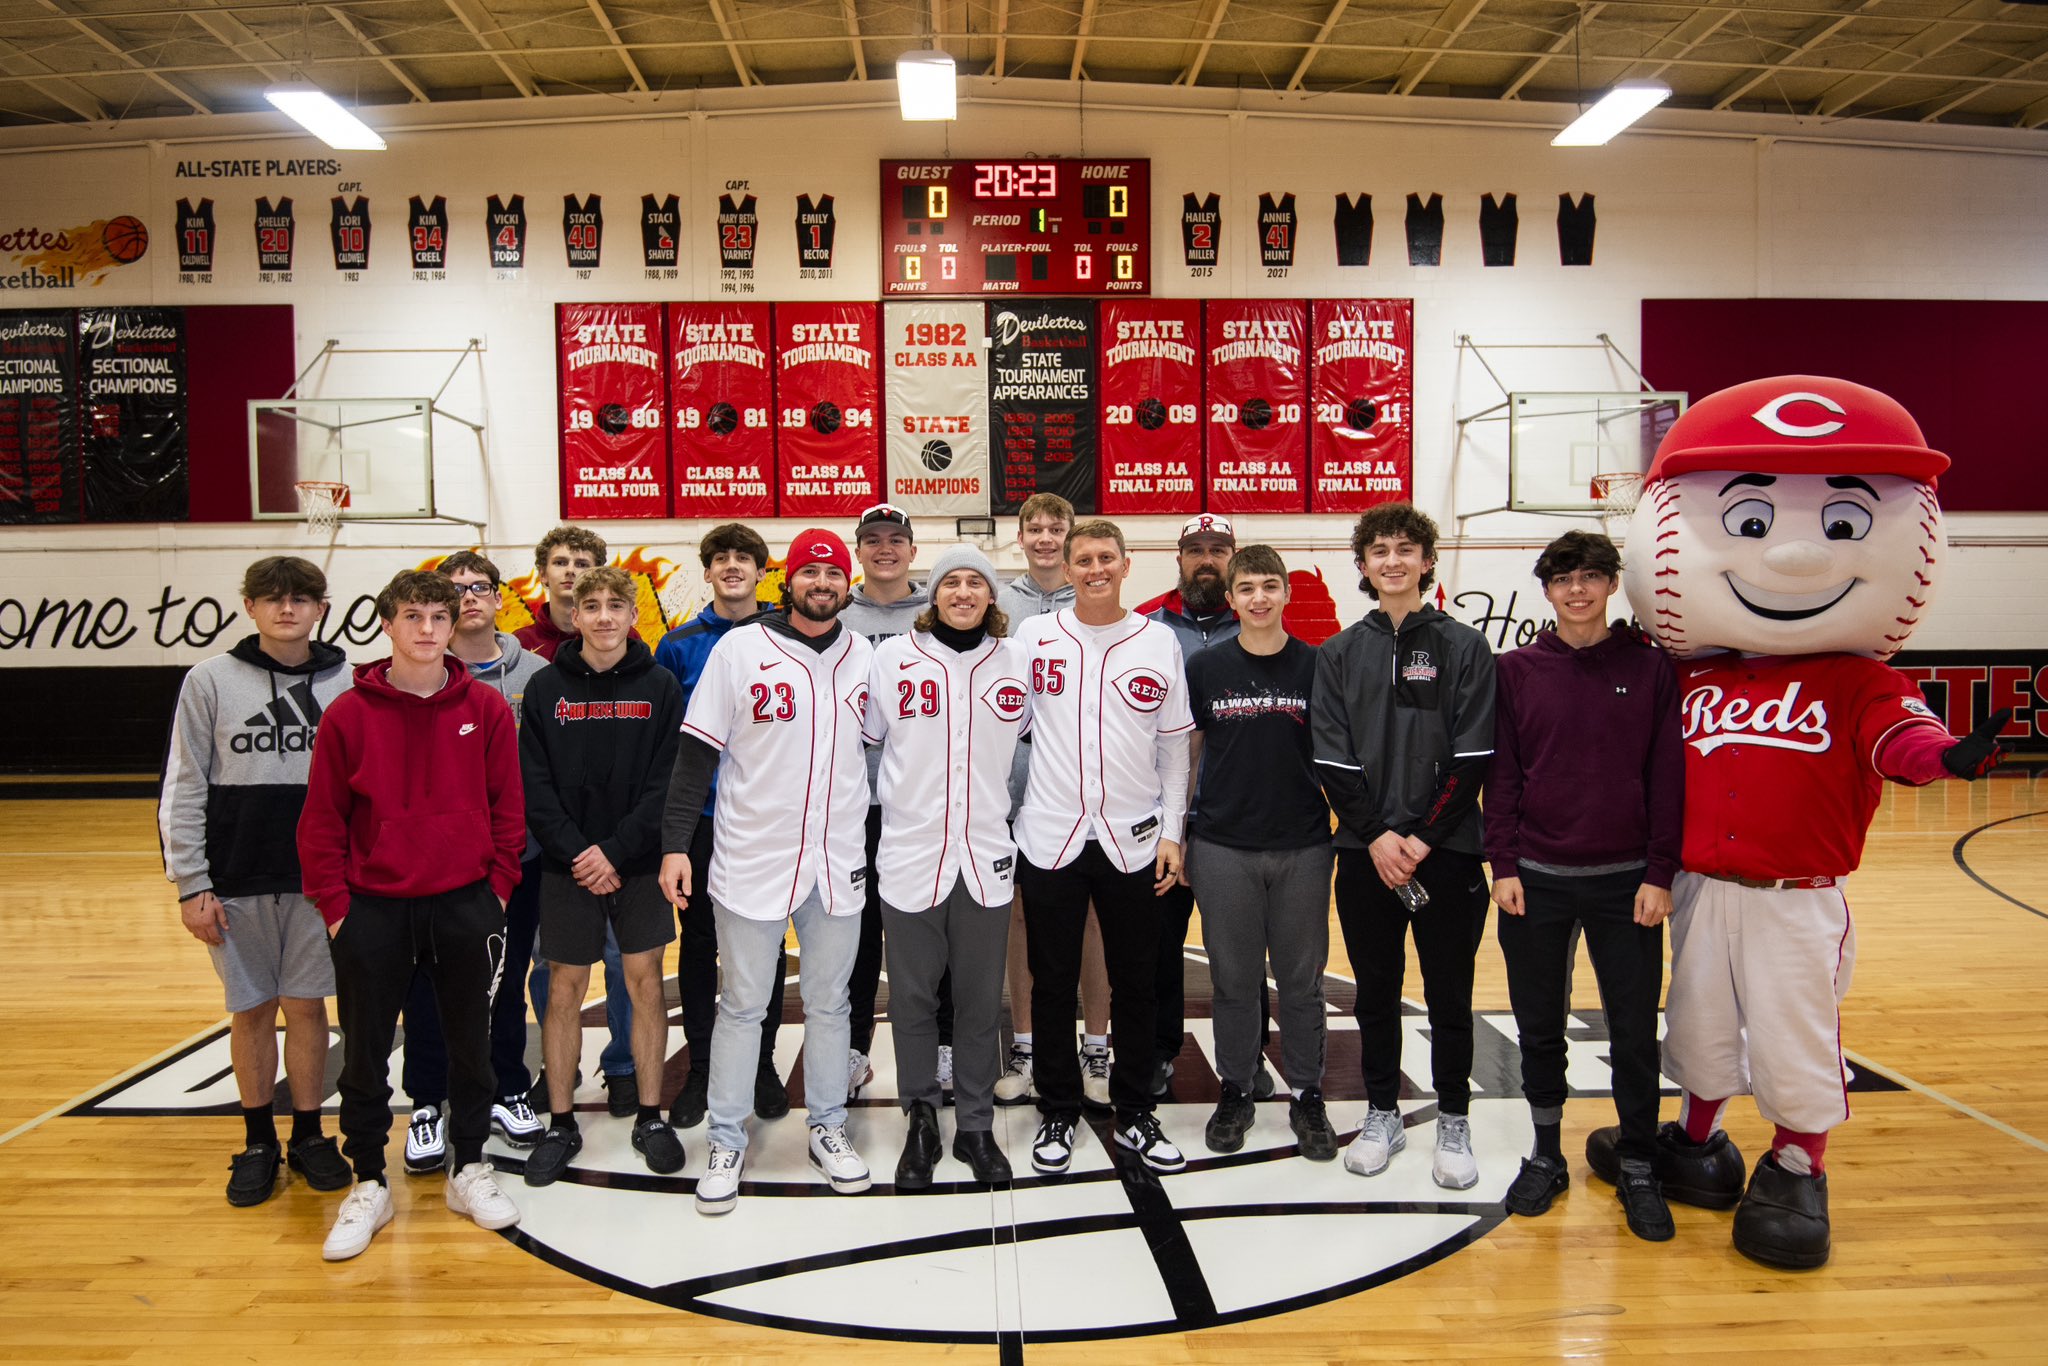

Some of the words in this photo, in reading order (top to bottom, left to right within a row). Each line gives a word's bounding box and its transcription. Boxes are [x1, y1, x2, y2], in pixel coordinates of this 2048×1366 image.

[176, 160, 261, 177] ALL-STATE
[266, 159, 341, 176] PLAYERS:
[897, 166, 953, 180] GUEST
[1081, 165, 1130, 179] HOME
[338, 182, 362, 192] CAPT.
[725, 180, 750, 191] CAPT.
[974, 165, 1057, 197] 20:23
[928, 185, 948, 218] 0
[1109, 185, 1128, 217] 0
[186, 218, 205, 227] KIM
[258, 217, 290, 227] SHELLEY
[340, 216, 361, 225] LORI
[419, 216, 437, 225] KIM
[494, 214, 519, 224] VICKI
[569, 214, 596, 223] STACY
[648, 213, 673, 223] STACI
[719, 214, 738, 224] MARY
[739, 214, 755, 224] BETH
[802, 214, 828, 224] EMILY
[972, 214, 1021, 226] PERIOD
[1037, 208, 1046, 233] 1
[1185, 212, 1216, 223] HAILEY
[1262, 212, 1291, 223] ANNIE
[185, 229, 208, 253] 11
[261, 228, 289, 252] 20
[339, 227, 363, 251] 10
[414, 227, 442, 251] 34
[496, 226, 518, 250] 4
[568, 225, 597, 249] 40
[722, 225, 751, 249] 23
[810, 225, 821, 248] 1
[1192, 224, 1211, 248] 2
[1266, 224, 1288, 249] 41
[570, 250, 597, 260] WILSON
[648, 249, 674, 260] SHAVER
[723, 250, 752, 260] VARNEY
[803, 249, 829, 260] RECTOR
[893, 244, 927, 253] FOULS
[938, 244, 959, 253] TOL
[980, 243, 1052, 253] PLAYER-FOUL
[1073, 243, 1093, 252] TOL
[1105, 243, 1139, 252] FOULS
[1188, 250, 1215, 260] MILLER
[1264, 250, 1290, 260] HUNT
[181, 255, 211, 265] CALDWELL
[262, 254, 289, 264] RITCHIE
[338, 253, 365, 263] CALDWELL
[415, 252, 441, 262] CREEL
[494, 251, 520, 261] TODD
[800, 269, 817, 280] 2010,
[818, 269, 833, 279] 2011
[905, 256, 921, 280] 0
[941, 256, 957, 280] 0
[1076, 255, 1091, 279] 0
[1117, 255, 1133, 279] 0
[1191, 267, 1213, 277] 2015
[1267, 268, 1288, 278] 2021
[344, 272, 359, 281] 1983
[576, 270, 592, 280] 1987
[720, 269, 737, 281] 1992,
[739, 269, 754, 279] 1993
[721, 283, 738, 294] 1994,
[739, 283, 755, 293] 1996
[889, 282, 928, 291] POINTS
[982, 281, 1020, 291] MATCH
[1105, 281, 1143, 290] POINTS
[90, 314, 177, 349] Devilettes
[578, 324, 646, 343] STATE
[685, 324, 754, 342] STATE
[791, 324, 861, 342] STATE
[905, 323, 967, 346] 1982
[996, 311, 1087, 346] Devilettes
[1116, 320, 1184, 339] STATE
[1223, 320, 1290, 339] STATE
[1327, 320, 1395, 339] STATE
[1021, 335, 1087, 348] Basketball
[567, 345, 659, 371] TOURNAMENT
[675, 344, 765, 370] TOURNAMENT
[781, 343, 872, 369] TOURNAMENT
[894, 352, 947, 367] CLASS
[952, 352, 977, 367] AA
[1022, 352, 1061, 367] STATE
[1106, 339, 1195, 367] TOURNAMENT
[1212, 339, 1300, 367] TOURNAMENT
[1317, 339, 1405, 367] TOURNAMENT
[92, 358, 173, 374] SECTIONAL
[998, 368, 1085, 384] TOURNAMENT
[89, 378, 177, 394] CHAMPIONS
[993, 384, 1088, 400] APPEARANCES
[569, 408, 594, 429] 19
[631, 408, 660, 428] 80
[676, 407, 700, 428] 19
[743, 407, 768, 428] 81
[782, 408, 806, 428] 19
[844, 407, 873, 428] 94
[1106, 404, 1133, 424] 20
[1168, 404, 1197, 424] 09
[1211, 404, 1238, 423] 20
[1277, 404, 1300, 423] 10
[1317, 403, 1343, 423] 20
[1380, 403, 1402, 423] 11
[1751, 392, 1847, 438] C
[903, 416, 970, 433] STATE
[579, 466, 626, 480] CLASS
[629, 466, 653, 480] AA
[686, 466, 734, 480] CLASS
[737, 466, 761, 479] AA
[791, 465, 840, 479] CLASS
[842, 465, 865, 479] AA
[1115, 462, 1162, 476] CLASS
[1164, 462, 1188, 475] AA
[1219, 461, 1267, 475] CLASS
[1269, 461, 1292, 475] AA
[1324, 461, 1371, 475] CLASS
[1373, 461, 1396, 475] AA
[574, 484, 619, 497] FINAL
[621, 483, 660, 497] FOUR
[681, 483, 726, 497] FINAL
[728, 483, 767, 496] FOUR
[786, 482, 831, 496] FINAL
[833, 481, 872, 495] FOUR
[894, 478, 980, 495] CHAMPIONS
[1109, 479, 1154, 493] FINAL
[1156, 478, 1194, 492] FOUR
[1213, 478, 1258, 492] FINAL
[1261, 478, 1298, 491] FOUR
[1318, 478, 1362, 492] FINAL
[1365, 477, 1402, 491] FOUR
[148, 585, 238, 648] to
[1411, 650, 1430, 667] R
[1031, 657, 1067, 695] 65
[1129, 681, 1167, 700] REDS
[750, 682, 797, 724] 23
[898, 679, 940, 720] 29
[1212, 697, 1273, 710] ALWAYS
[1277, 697, 1307, 709] FUN
[1682, 682, 1831, 748] Reds
